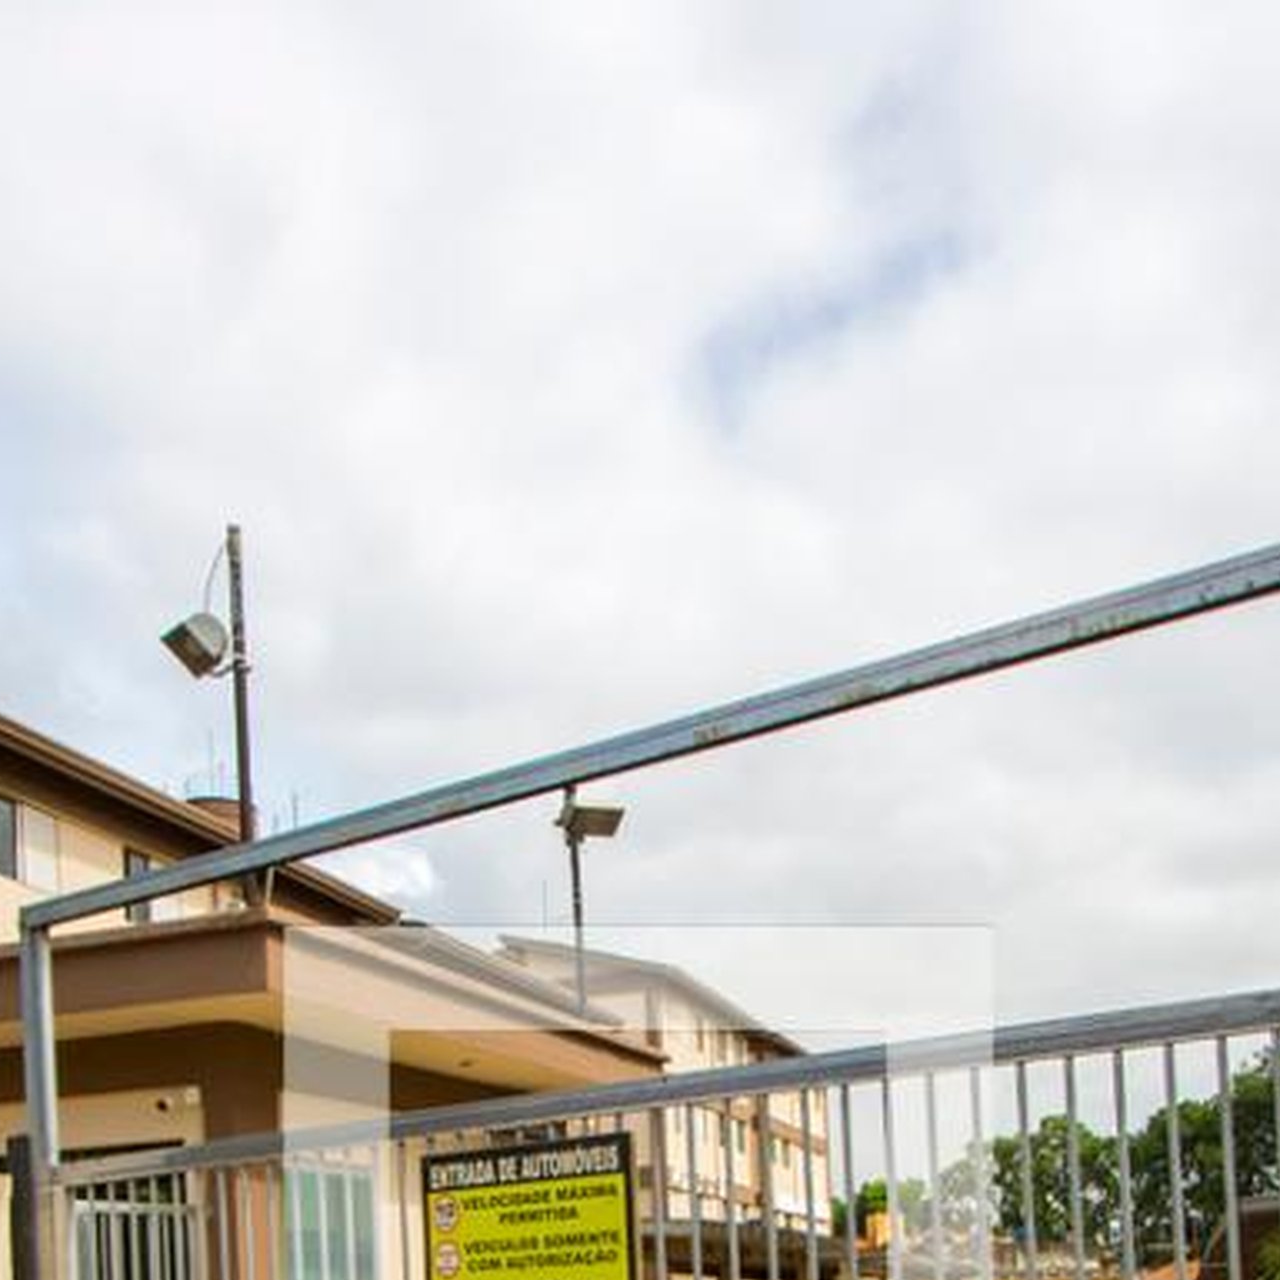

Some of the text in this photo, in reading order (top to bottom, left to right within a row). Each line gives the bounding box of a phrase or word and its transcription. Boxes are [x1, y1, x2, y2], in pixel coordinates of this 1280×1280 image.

[430, 1160, 495, 1190] ENTRADA
[498, 1155, 517, 1182] DE
[461, 1189, 551, 1210] VELOCIDADE
[499, 1206, 579, 1224] PERMITIDA
[544, 1230, 619, 1248] SOMENTE
[467, 1249, 618, 1272] COM AUTORIZAÇÃO
